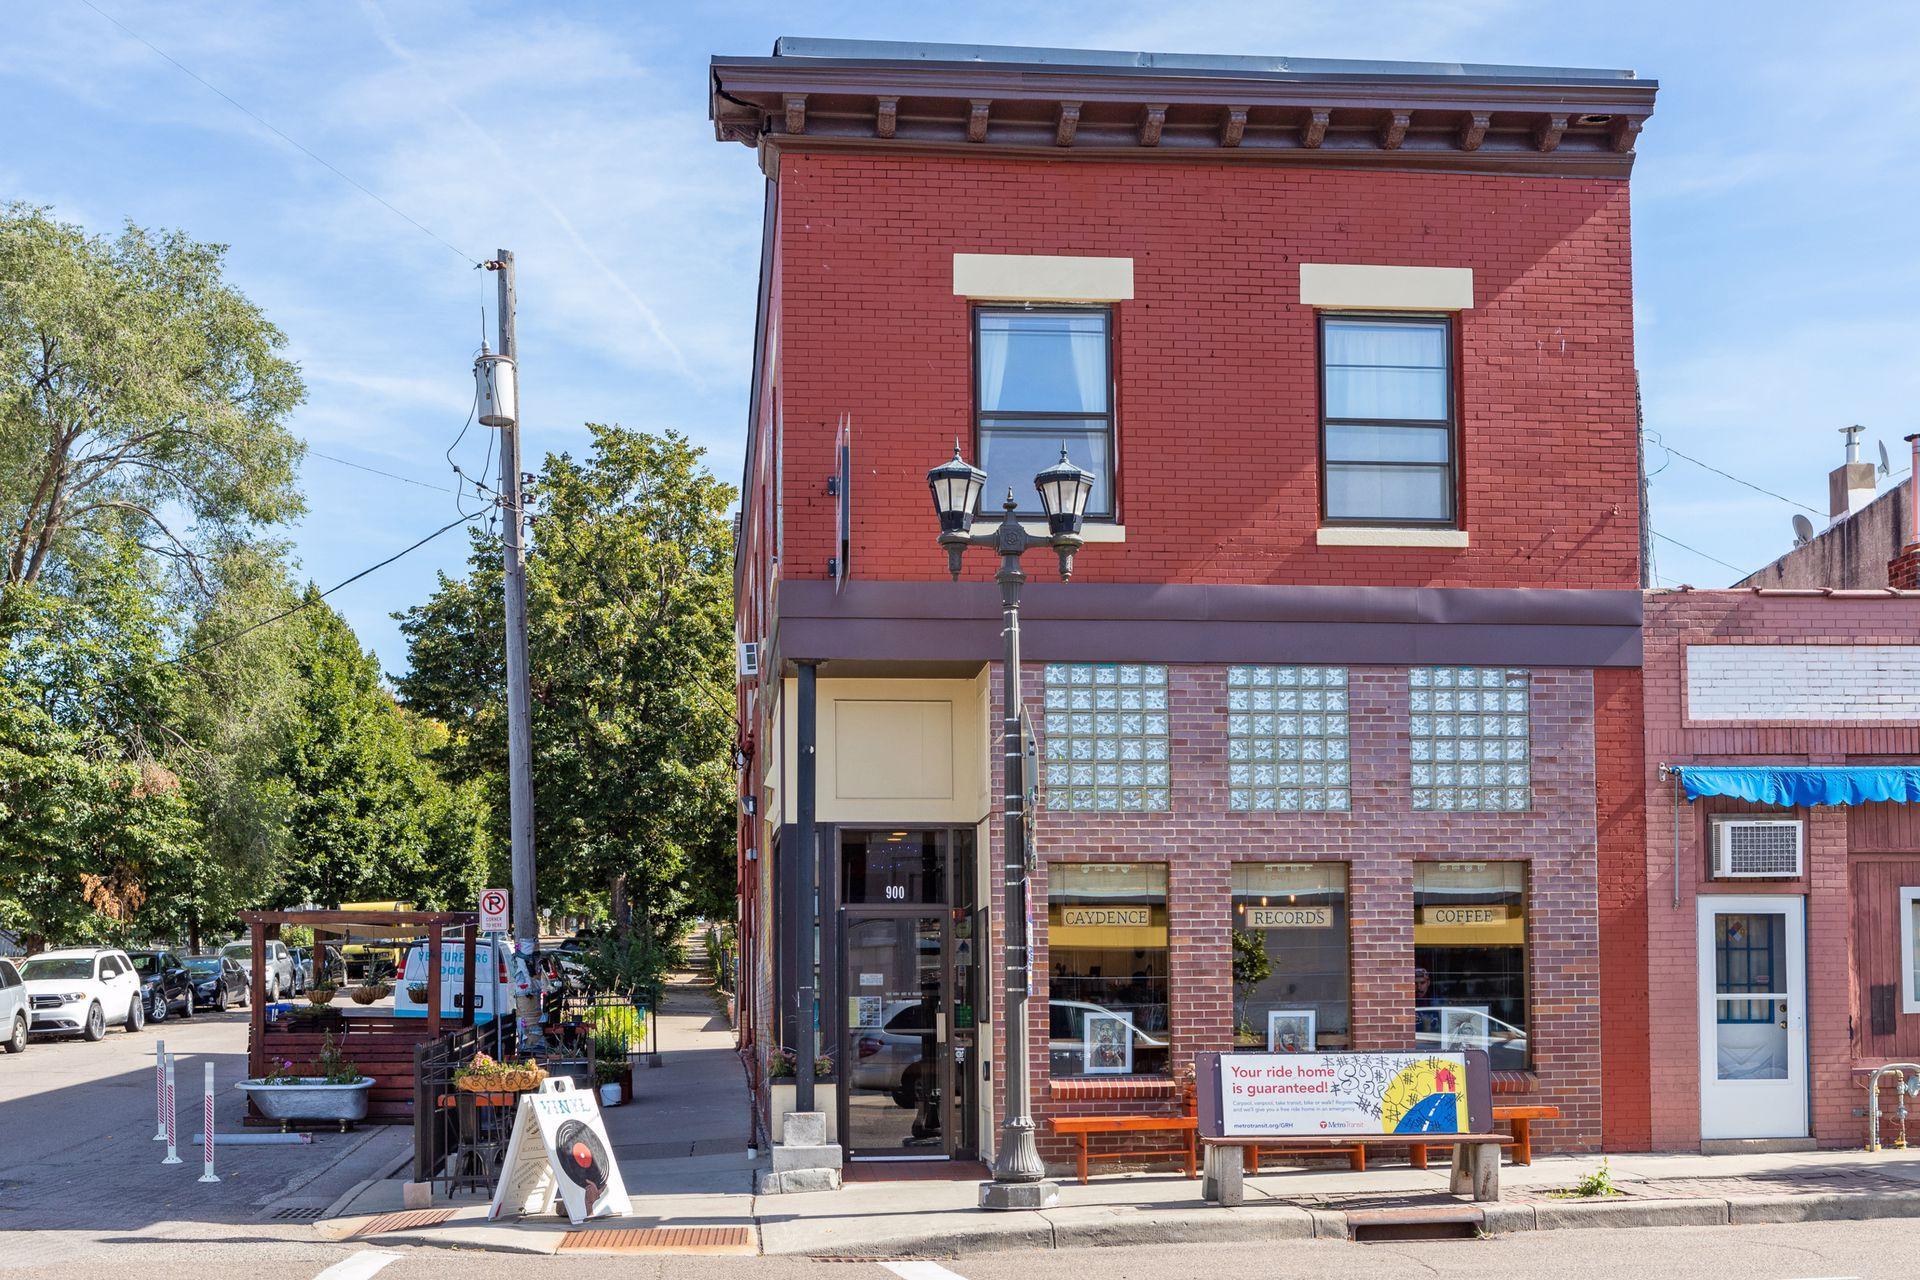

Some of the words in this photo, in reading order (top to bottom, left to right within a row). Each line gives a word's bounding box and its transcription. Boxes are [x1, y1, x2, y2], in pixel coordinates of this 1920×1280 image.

[886, 885, 905, 900] 900
[1065, 910, 1148, 925] CAYDENCE
[1254, 911, 1325, 925] RECORDS
[1435, 909, 1493, 923] COFFEE
[1231, 1066, 1262, 1078] Your
[1266, 1066, 1293, 1078] ride
[1297, 1065, 1335, 1078] home
[1232, 1082, 1243, 1094] is
[1247, 1081, 1328, 1097] guaranteed!
[540, 1098, 592, 1114] VINYL
